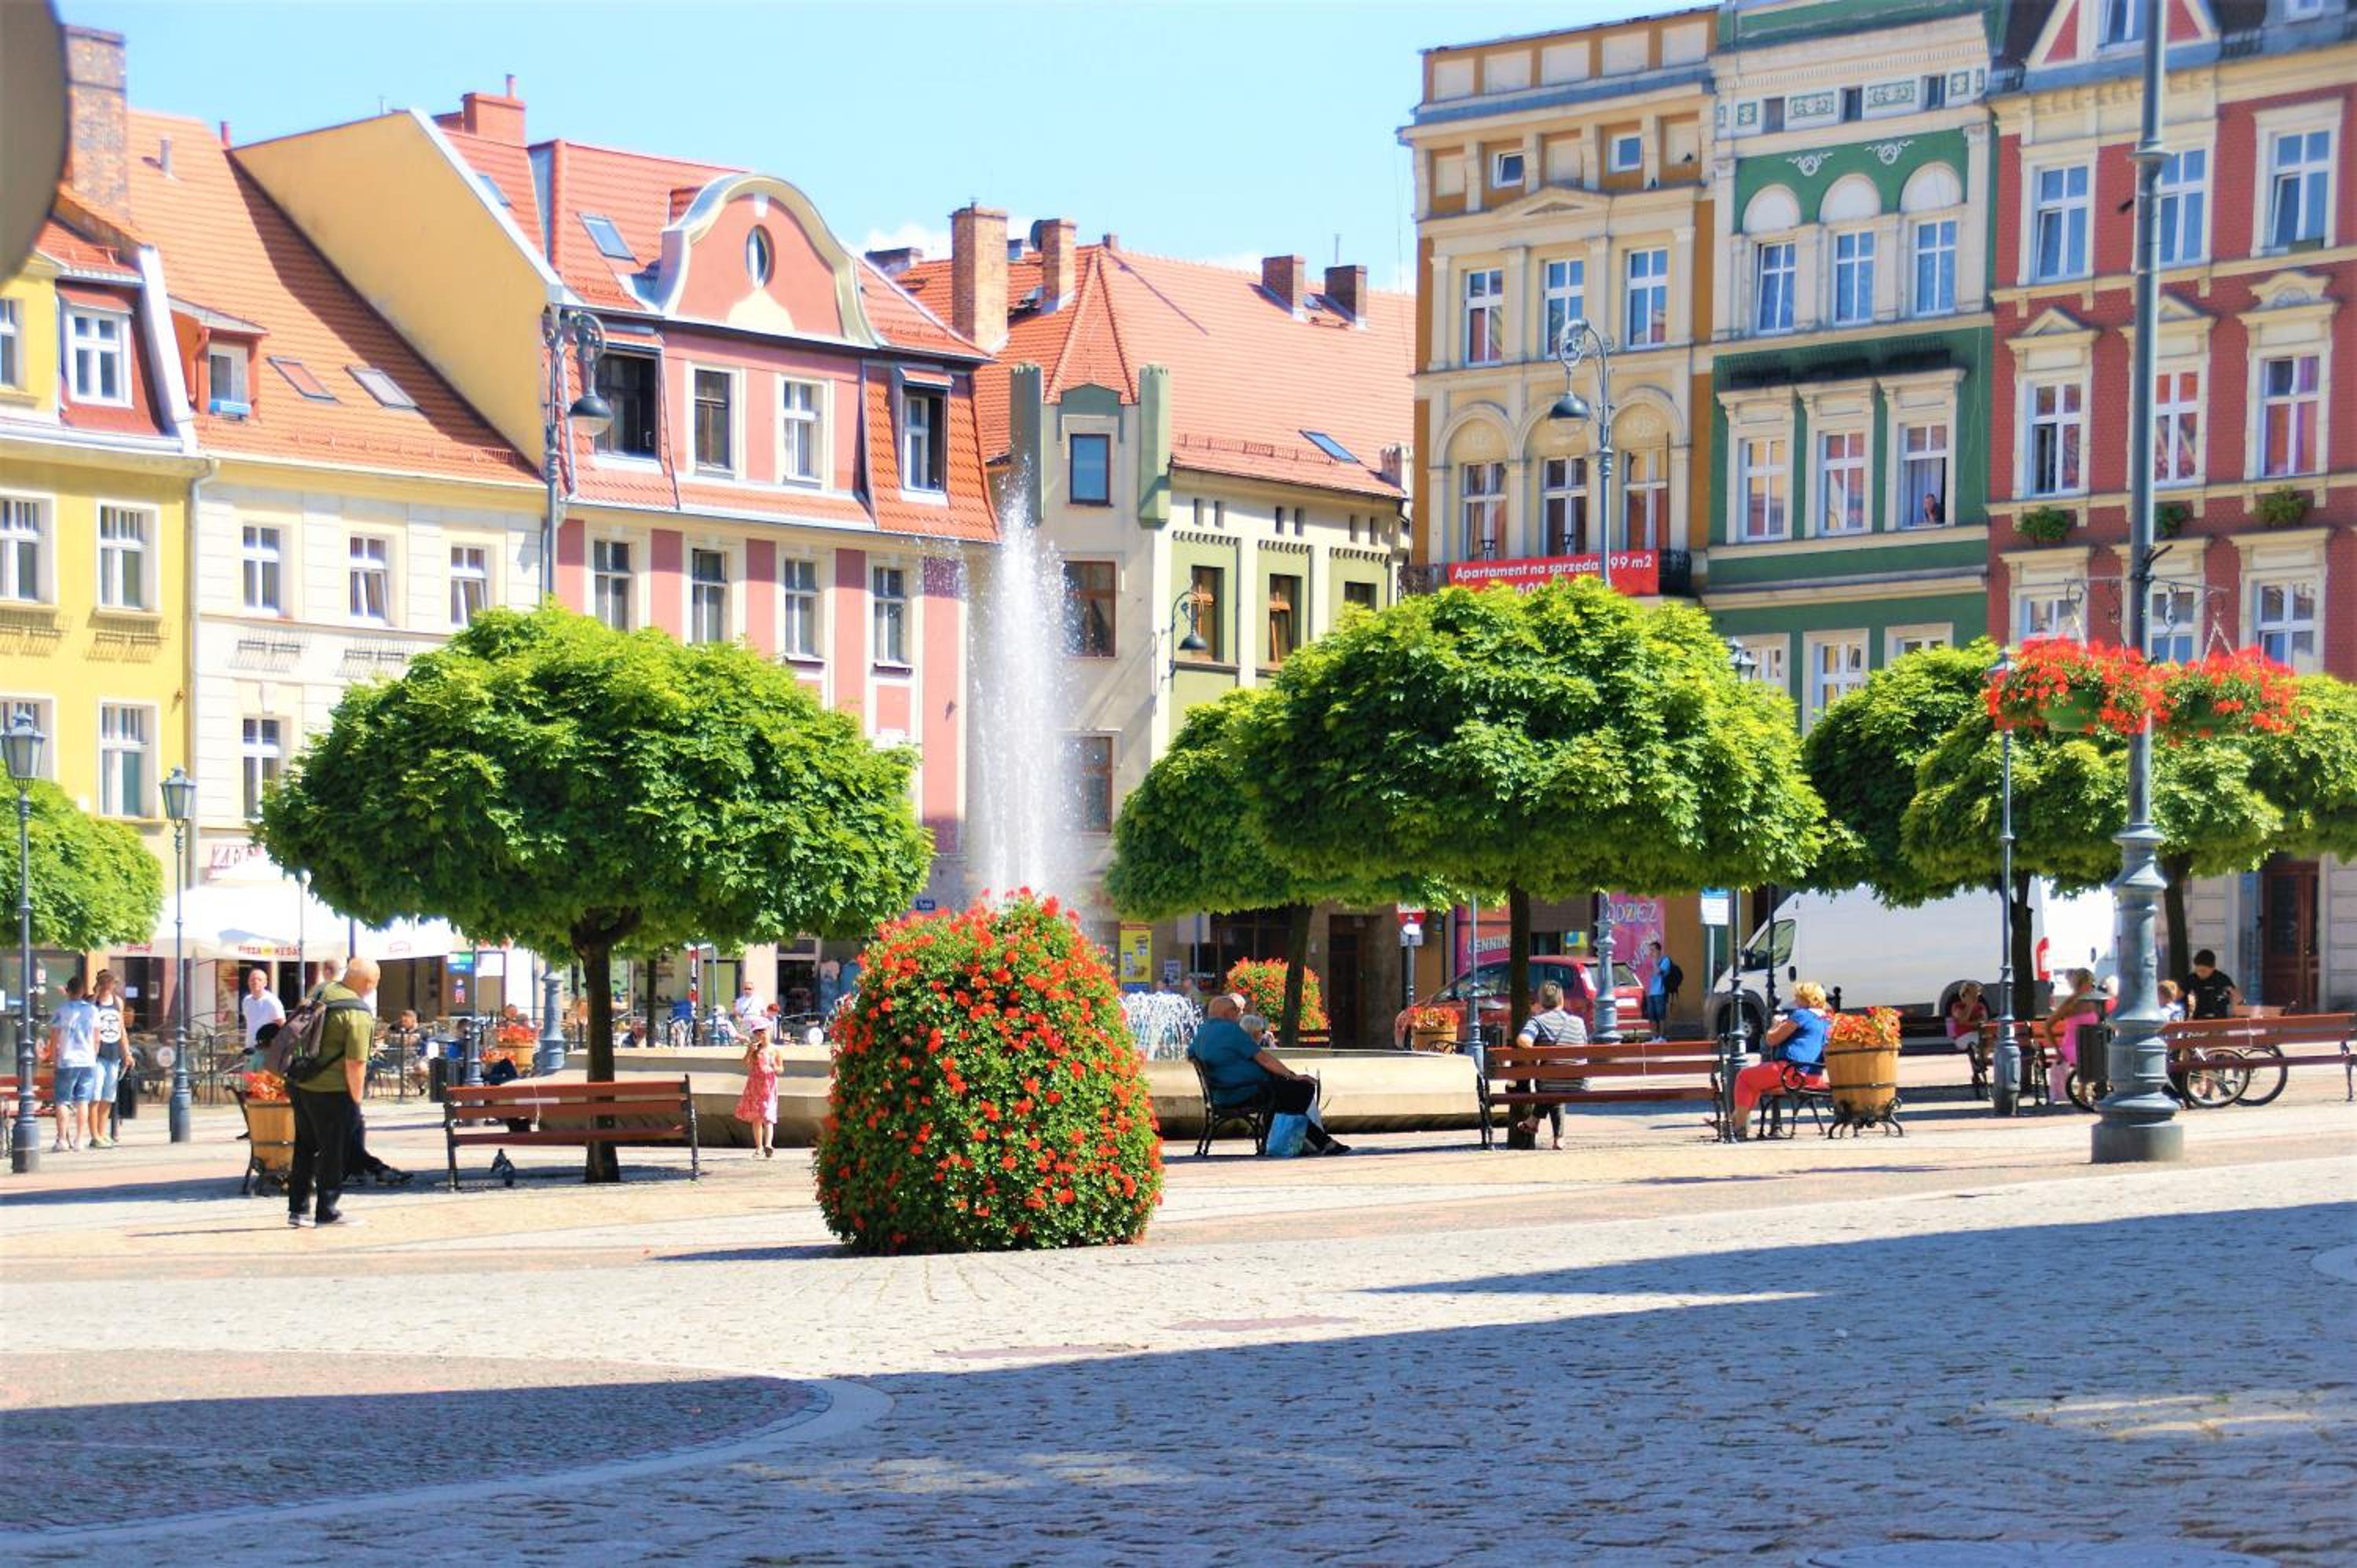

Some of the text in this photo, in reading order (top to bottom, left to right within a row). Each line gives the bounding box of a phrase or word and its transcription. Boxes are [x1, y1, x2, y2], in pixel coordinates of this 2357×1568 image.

[1455, 554, 1652, 582] Apartament na sprzeda 99 m2
